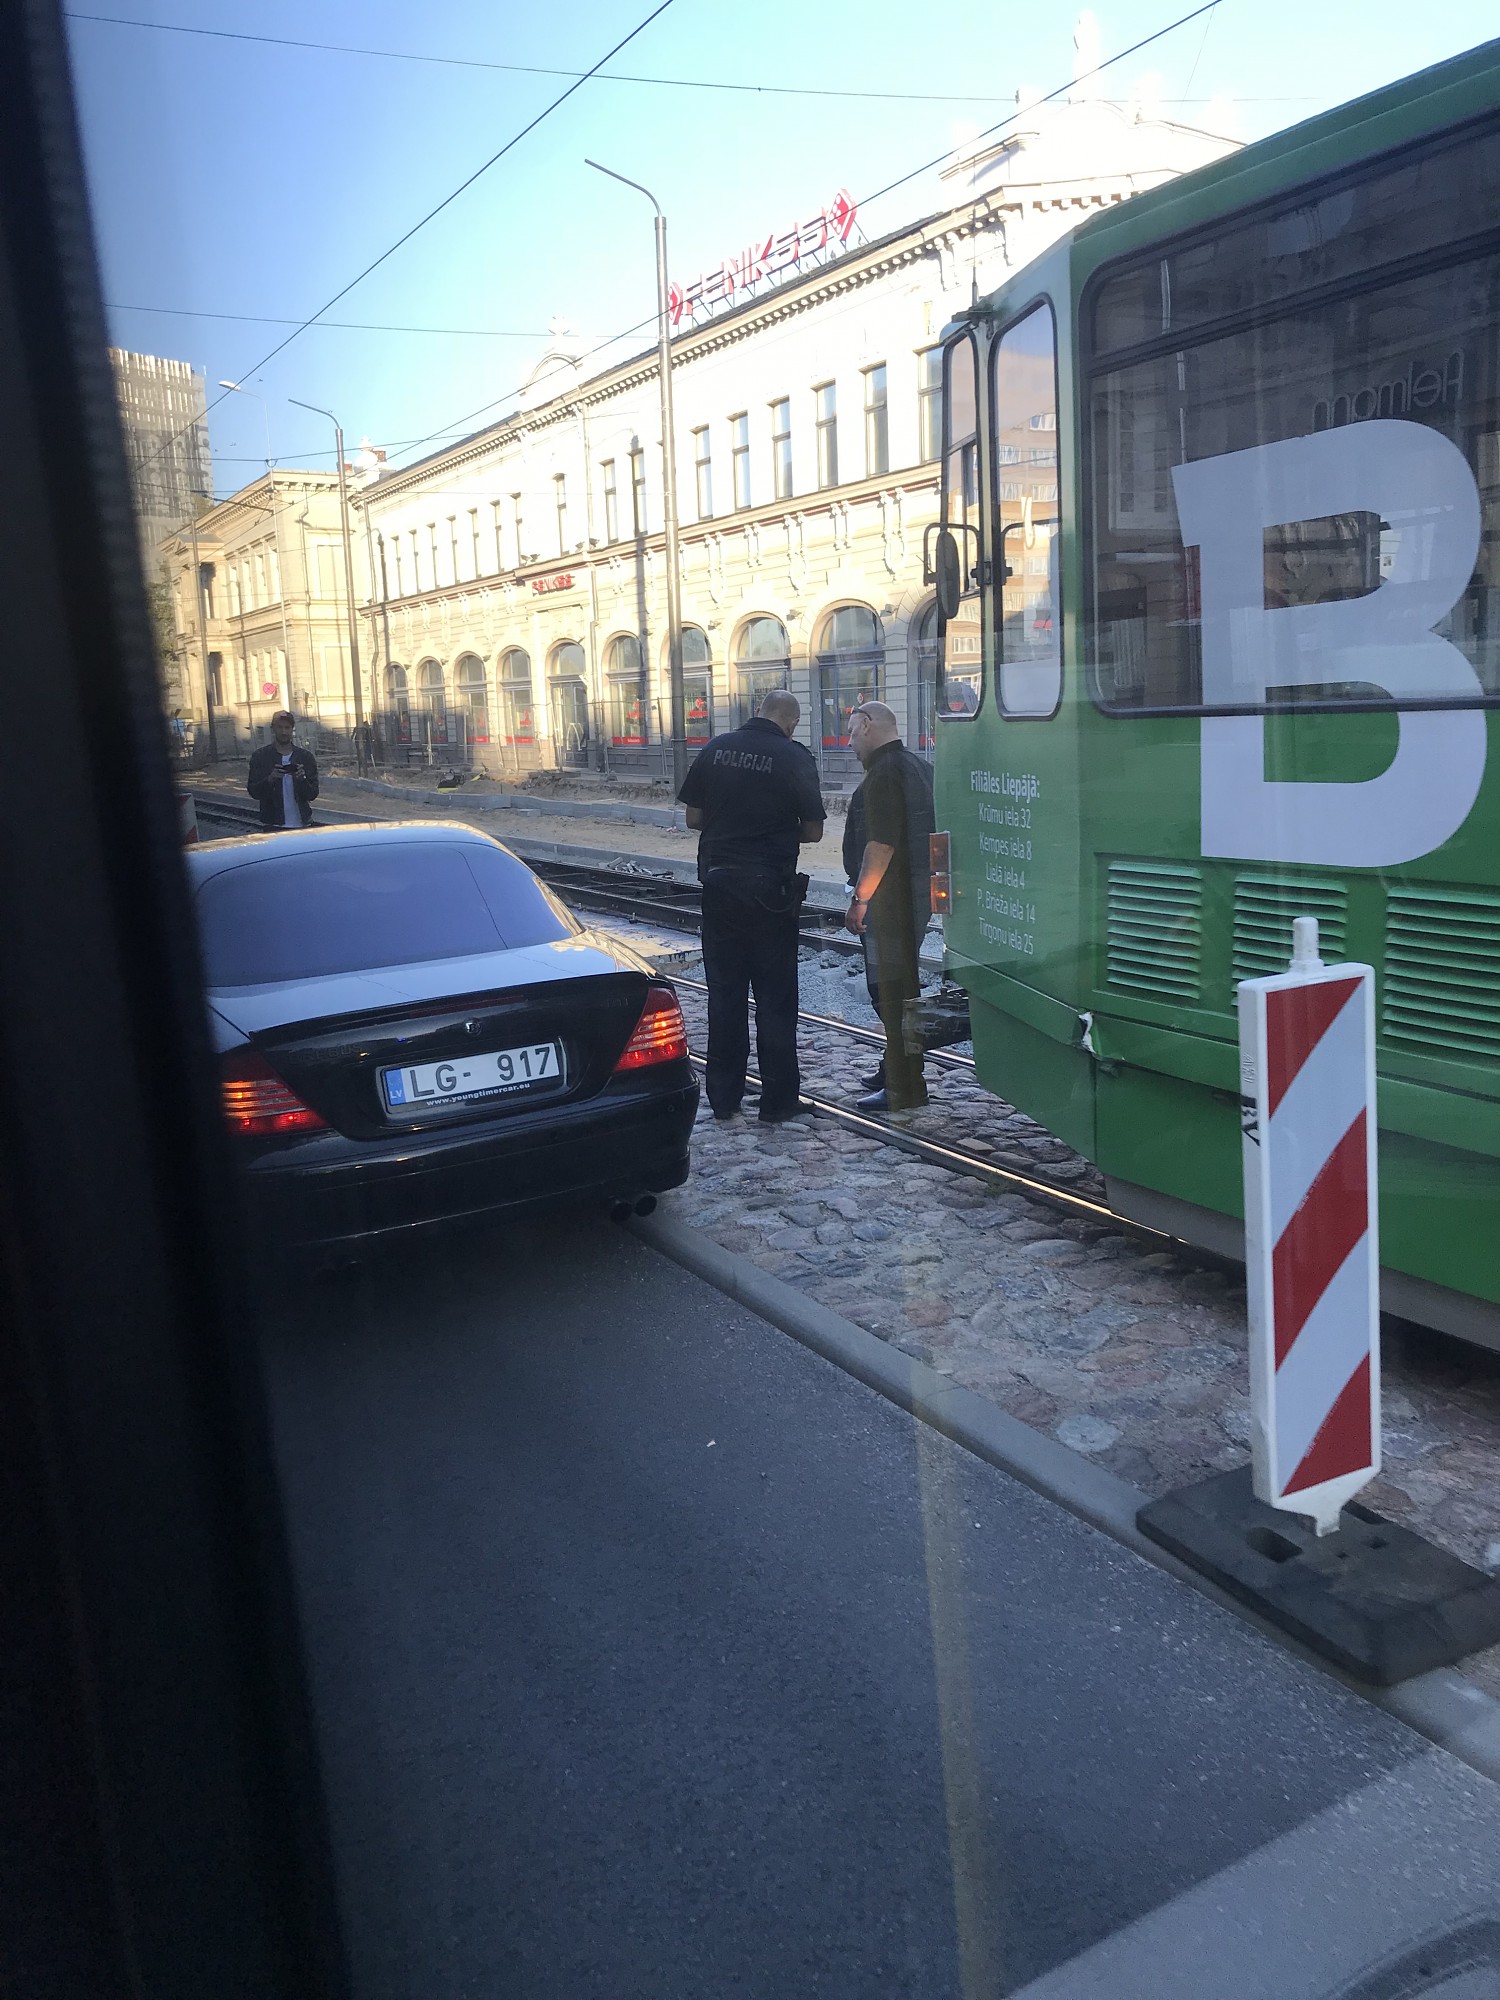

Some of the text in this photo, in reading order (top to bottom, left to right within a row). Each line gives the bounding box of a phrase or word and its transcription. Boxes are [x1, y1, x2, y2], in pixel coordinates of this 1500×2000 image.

[1171, 418, 1488, 870] B
[713, 749, 773, 773] POLICIJA
[971, 770, 1040, 803] Filiāles Liepājā:
[979, 802, 1031, 828] Krūmu iela 32
[1010, 837, 1025, 859] iela
[1026, 840, 1032, 861] 8
[986, 862, 1025, 890] Lielā iela 4
[977, 888, 1036, 924] P. Brieža iela 14
[1008, 927, 1022, 951] iela
[1023, 933, 1034, 955] 25
[497, 1046, 551, 1081] 917
[389, 1088, 402, 1099] LV
[426, 1082, 531, 1106] www.youngtimercar.eu
